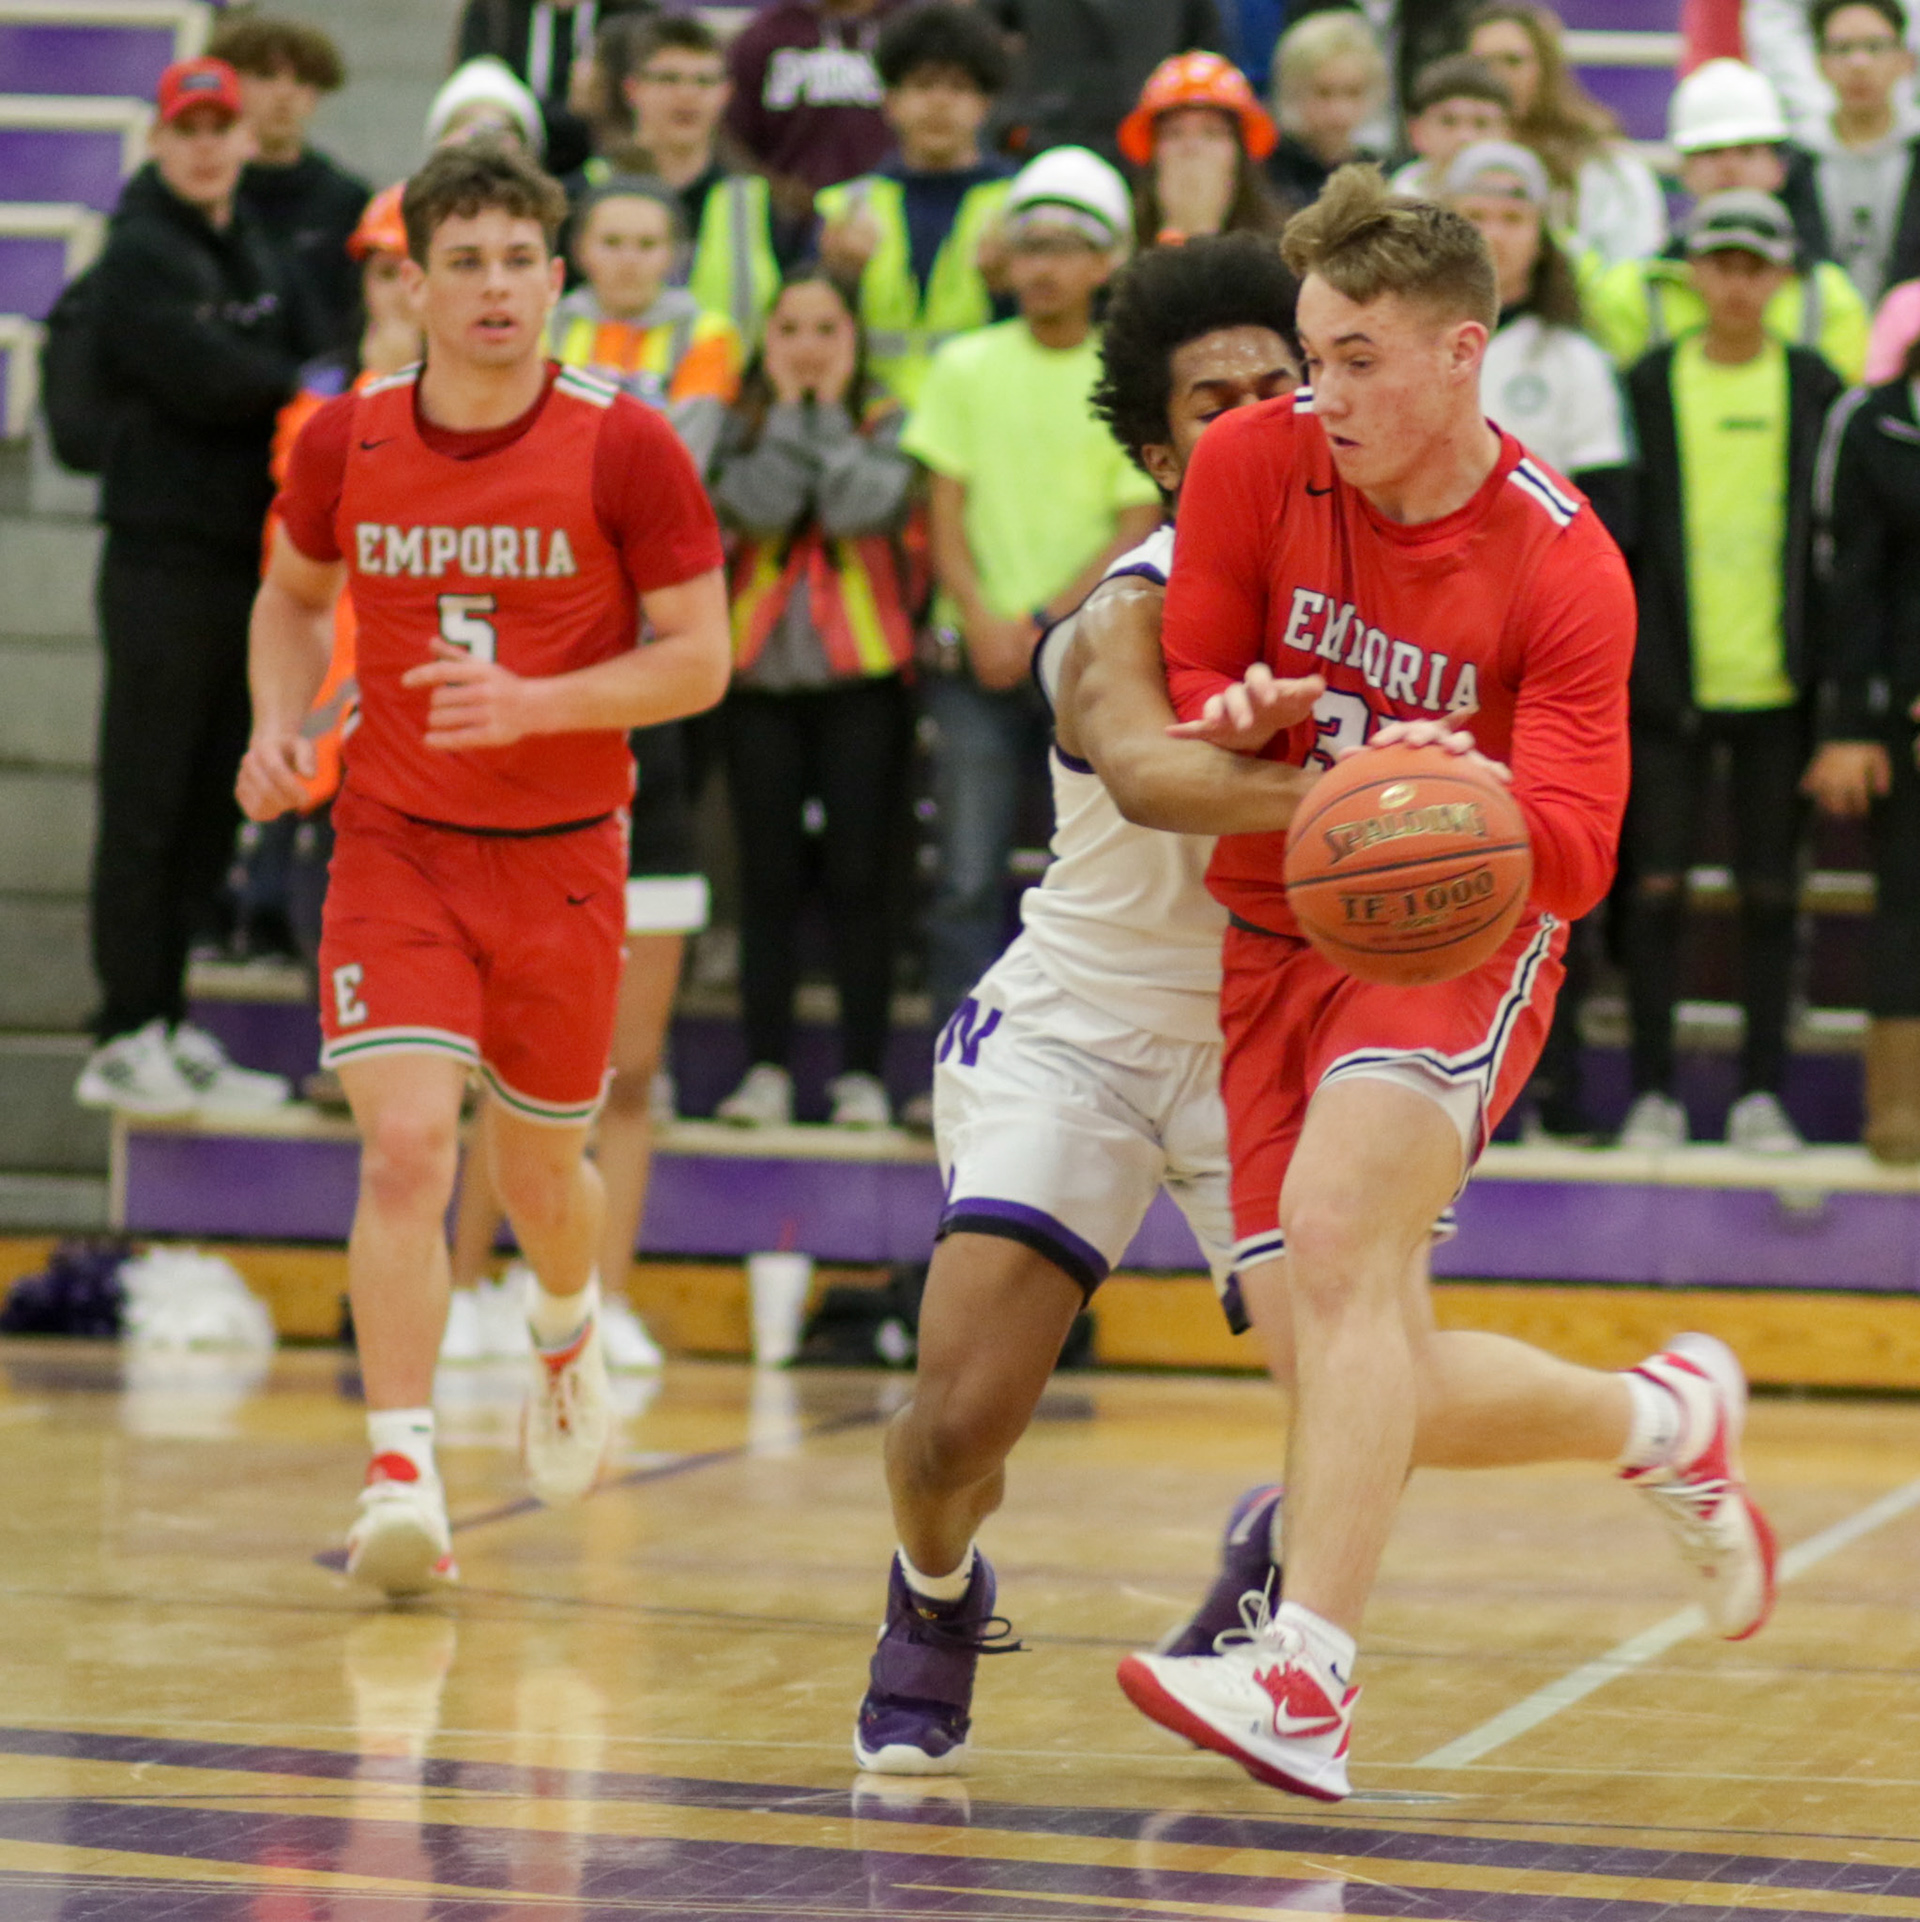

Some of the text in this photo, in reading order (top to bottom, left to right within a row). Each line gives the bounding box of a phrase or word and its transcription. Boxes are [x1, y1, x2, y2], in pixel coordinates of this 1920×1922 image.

[356, 522, 578, 578] EMPORIA
[437, 593, 497, 686] 5
[1341, 870, 1495, 920] TF-1000
[332, 962, 367, 1027] E
